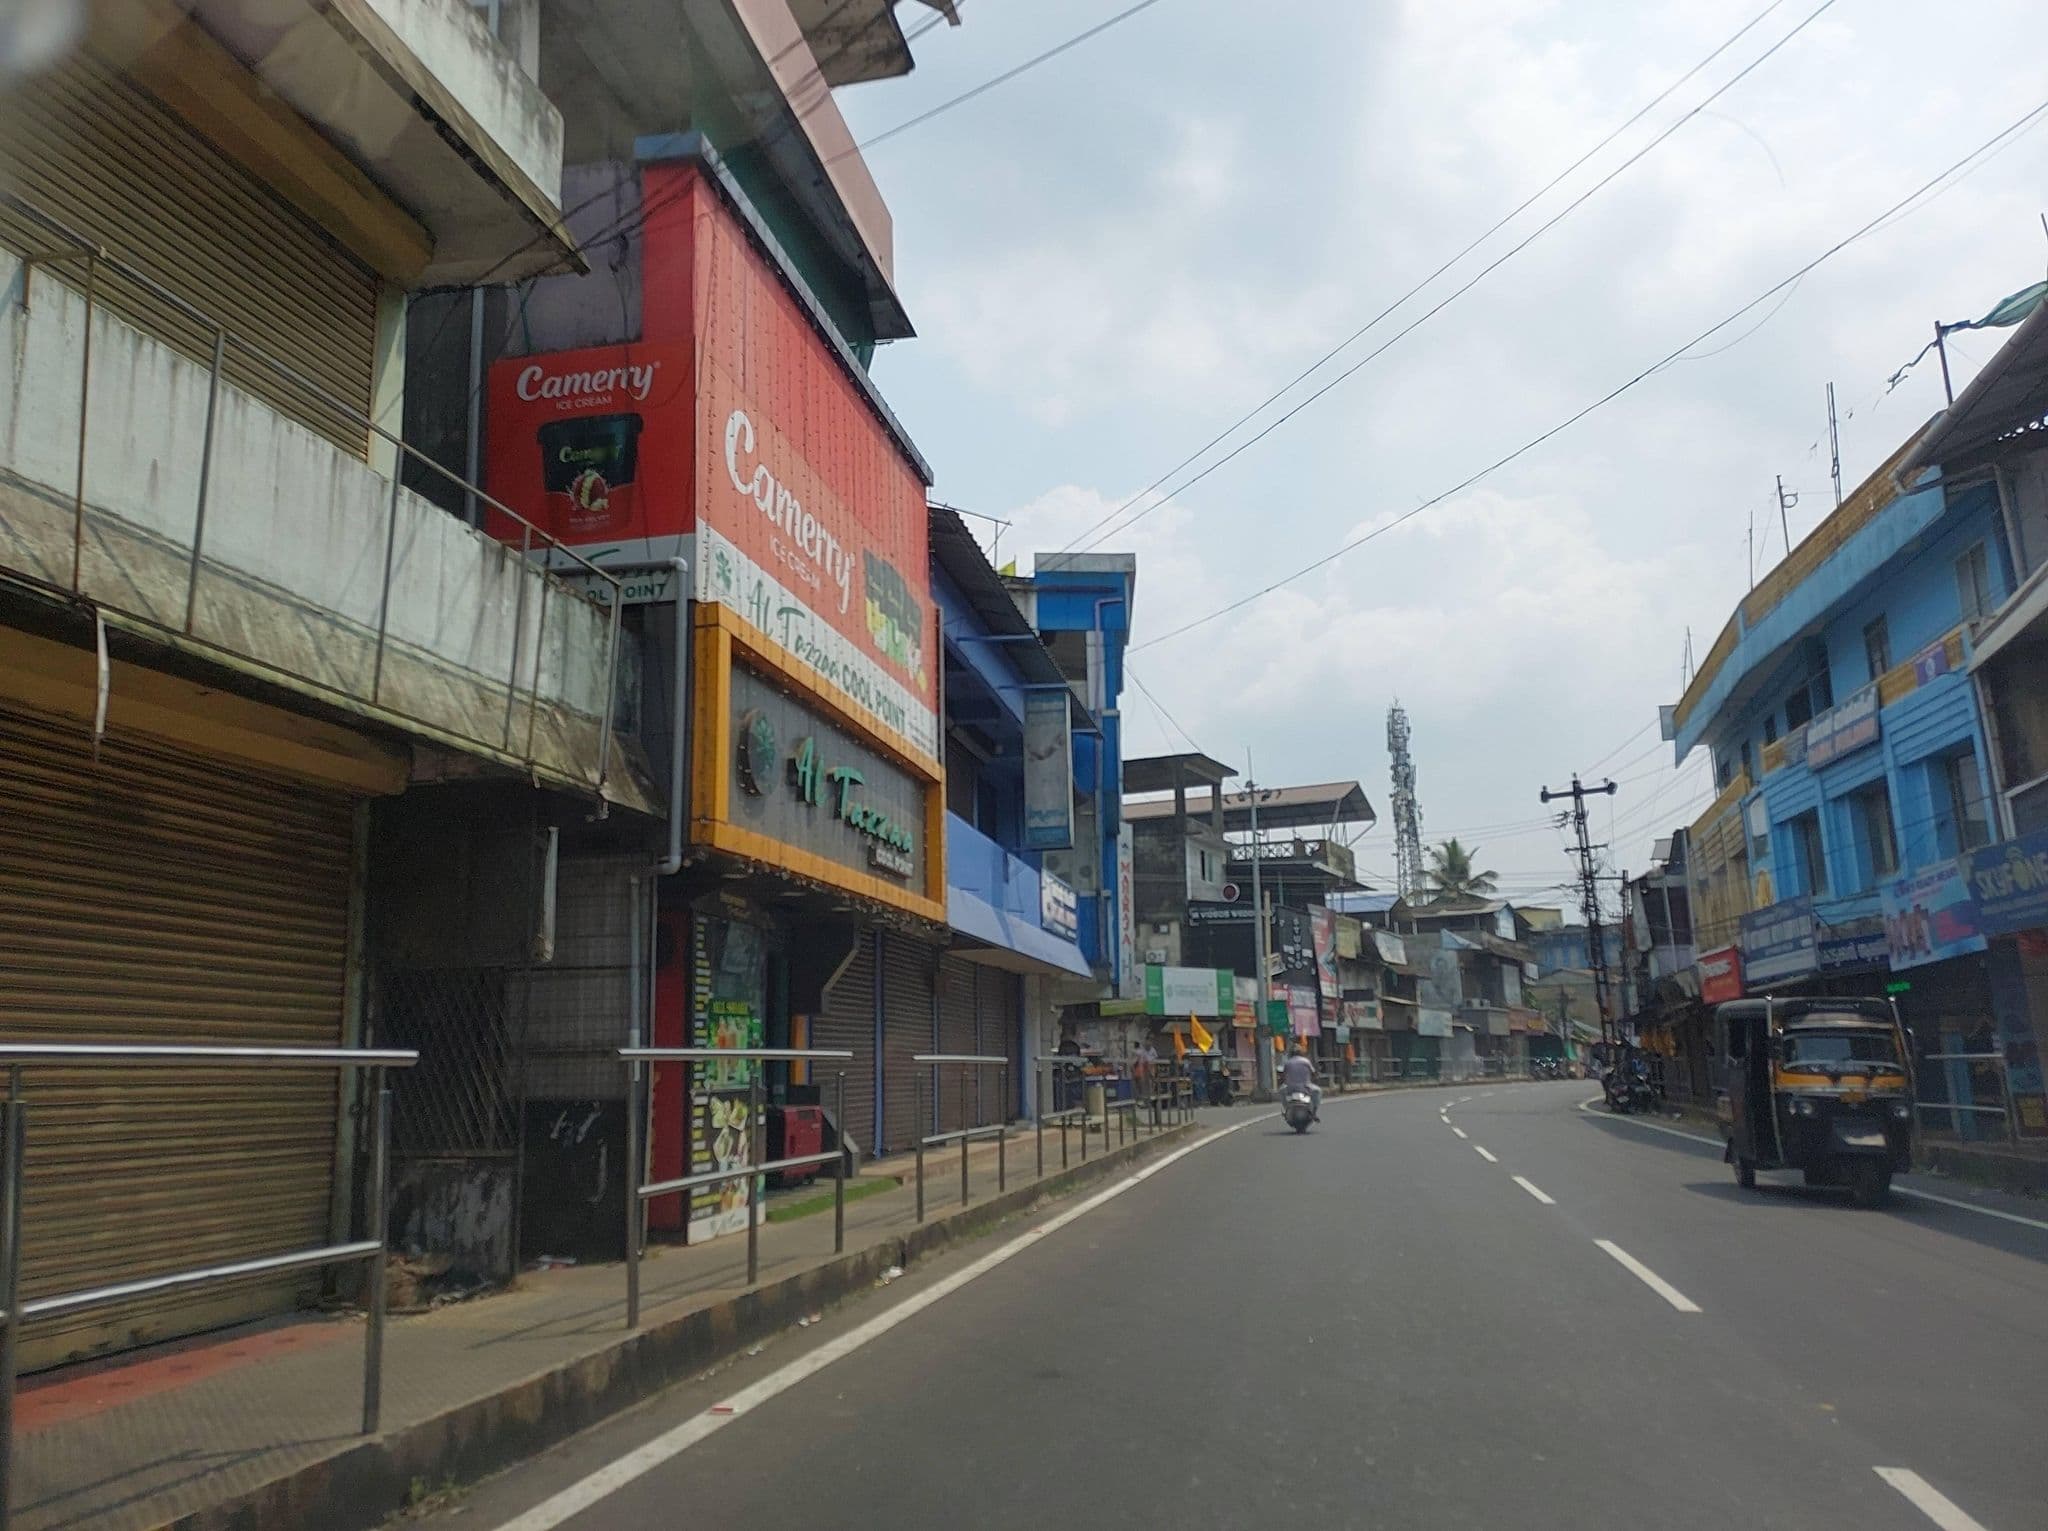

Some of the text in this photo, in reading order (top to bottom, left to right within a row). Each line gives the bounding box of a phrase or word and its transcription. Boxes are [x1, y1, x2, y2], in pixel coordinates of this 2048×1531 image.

[516, 365, 654, 401] Camerry
[556, 396, 612, 410] ICE CREAM
[724, 410, 853, 615] Camerry
[624, 583, 666, 599] OINT
[842, 663, 873, 710] COOL
[874, 688, 906, 735] POINT
